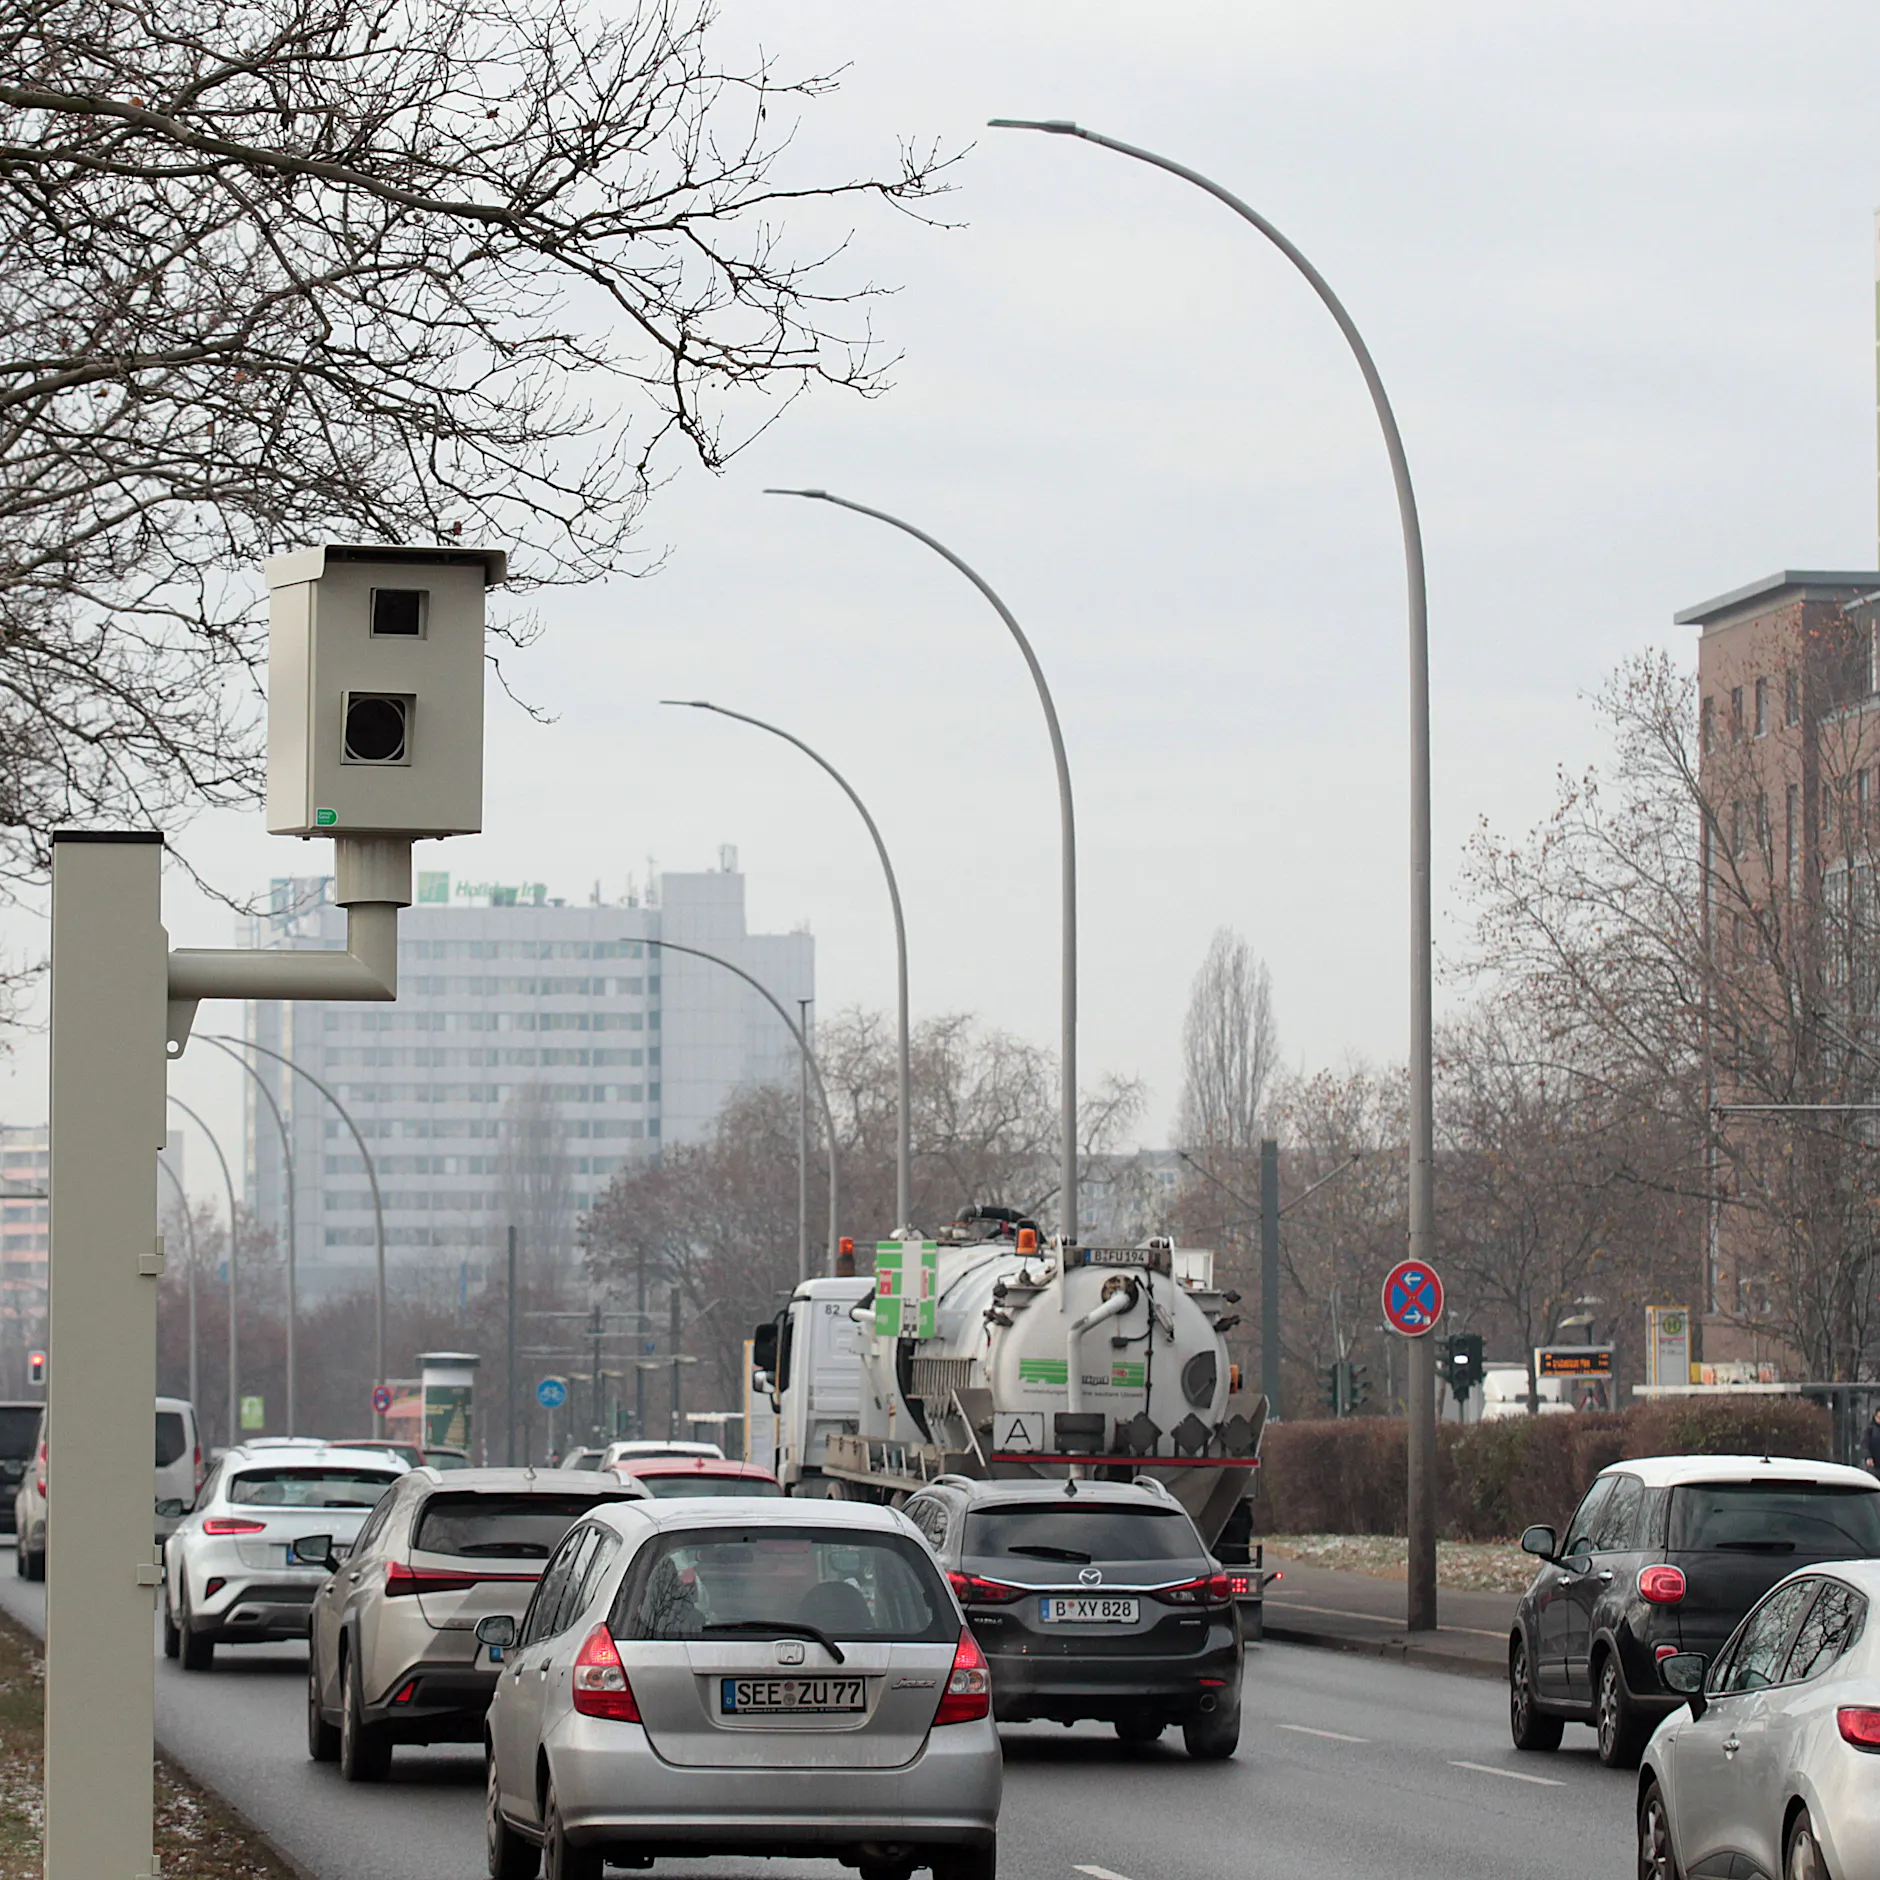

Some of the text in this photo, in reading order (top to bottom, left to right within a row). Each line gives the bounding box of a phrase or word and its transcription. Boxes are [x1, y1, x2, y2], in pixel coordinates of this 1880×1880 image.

[1095, 1251, 1144, 1261] B FU 194
[825, 1304, 840, 1315] 82
[1005, 1418, 1031, 1444] A
[1056, 1601, 1131, 1617] B XY 828
[737, 1682, 861, 1705] SEE ZU 77
